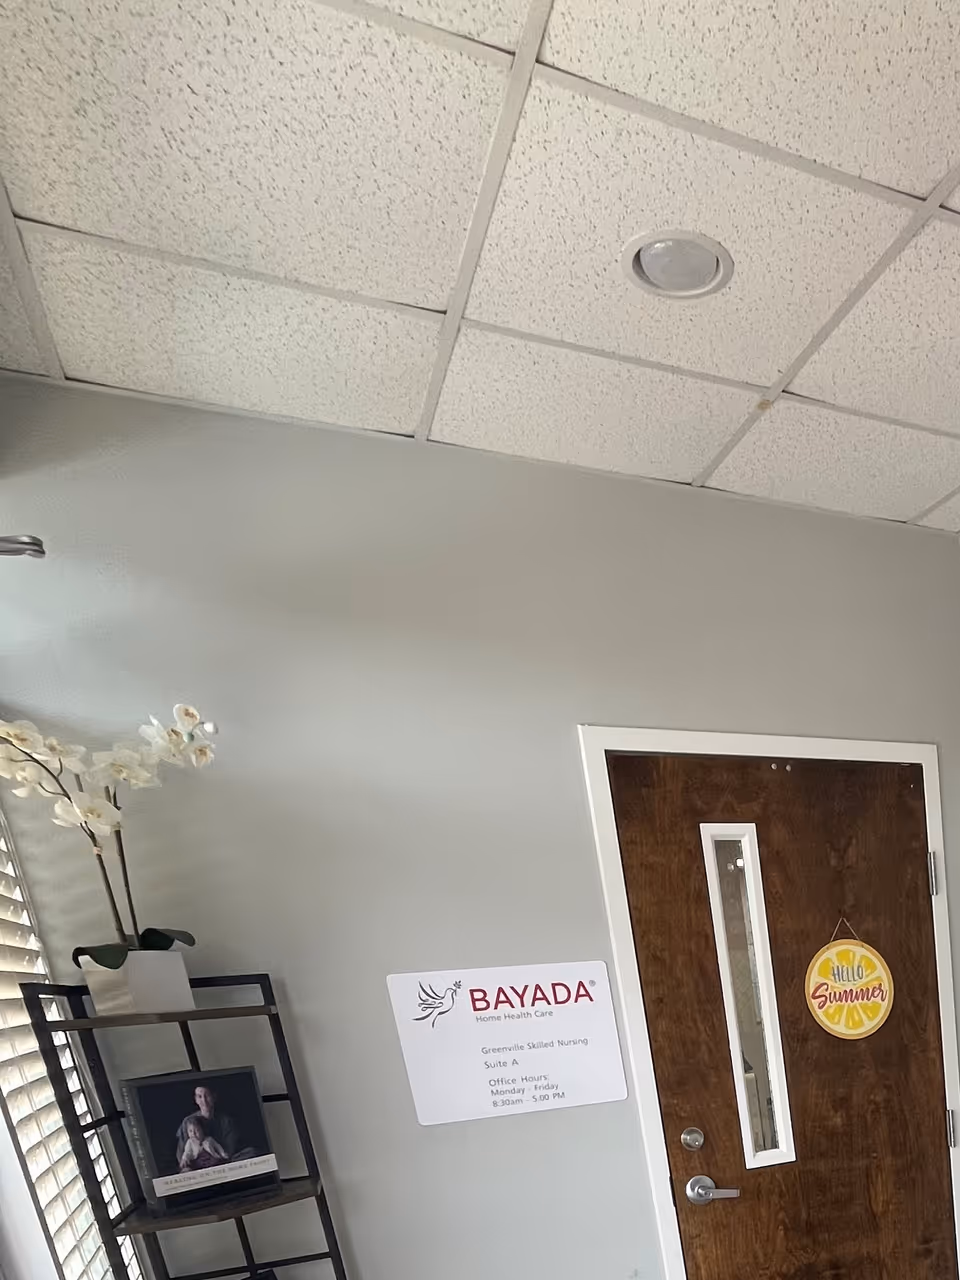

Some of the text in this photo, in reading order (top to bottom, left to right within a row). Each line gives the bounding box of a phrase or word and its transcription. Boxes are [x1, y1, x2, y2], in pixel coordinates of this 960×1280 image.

[831, 964, 864, 983] HELLO
[811, 982, 888, 1010] Summer
[475, 1009, 553, 1023] Home Health Care
[481, 1038, 589, 1055] Greenville Skilled Nursing
[484, 1058, 519, 1069] Suite A
[488, 1077, 517, 1087] Office
[490, 1087, 525, 1096] Monday
[534, 1083, 559, 1092] Friday
[492, 1098, 523, 1107] 8:30am
[552, 1092, 566, 1100] PM
